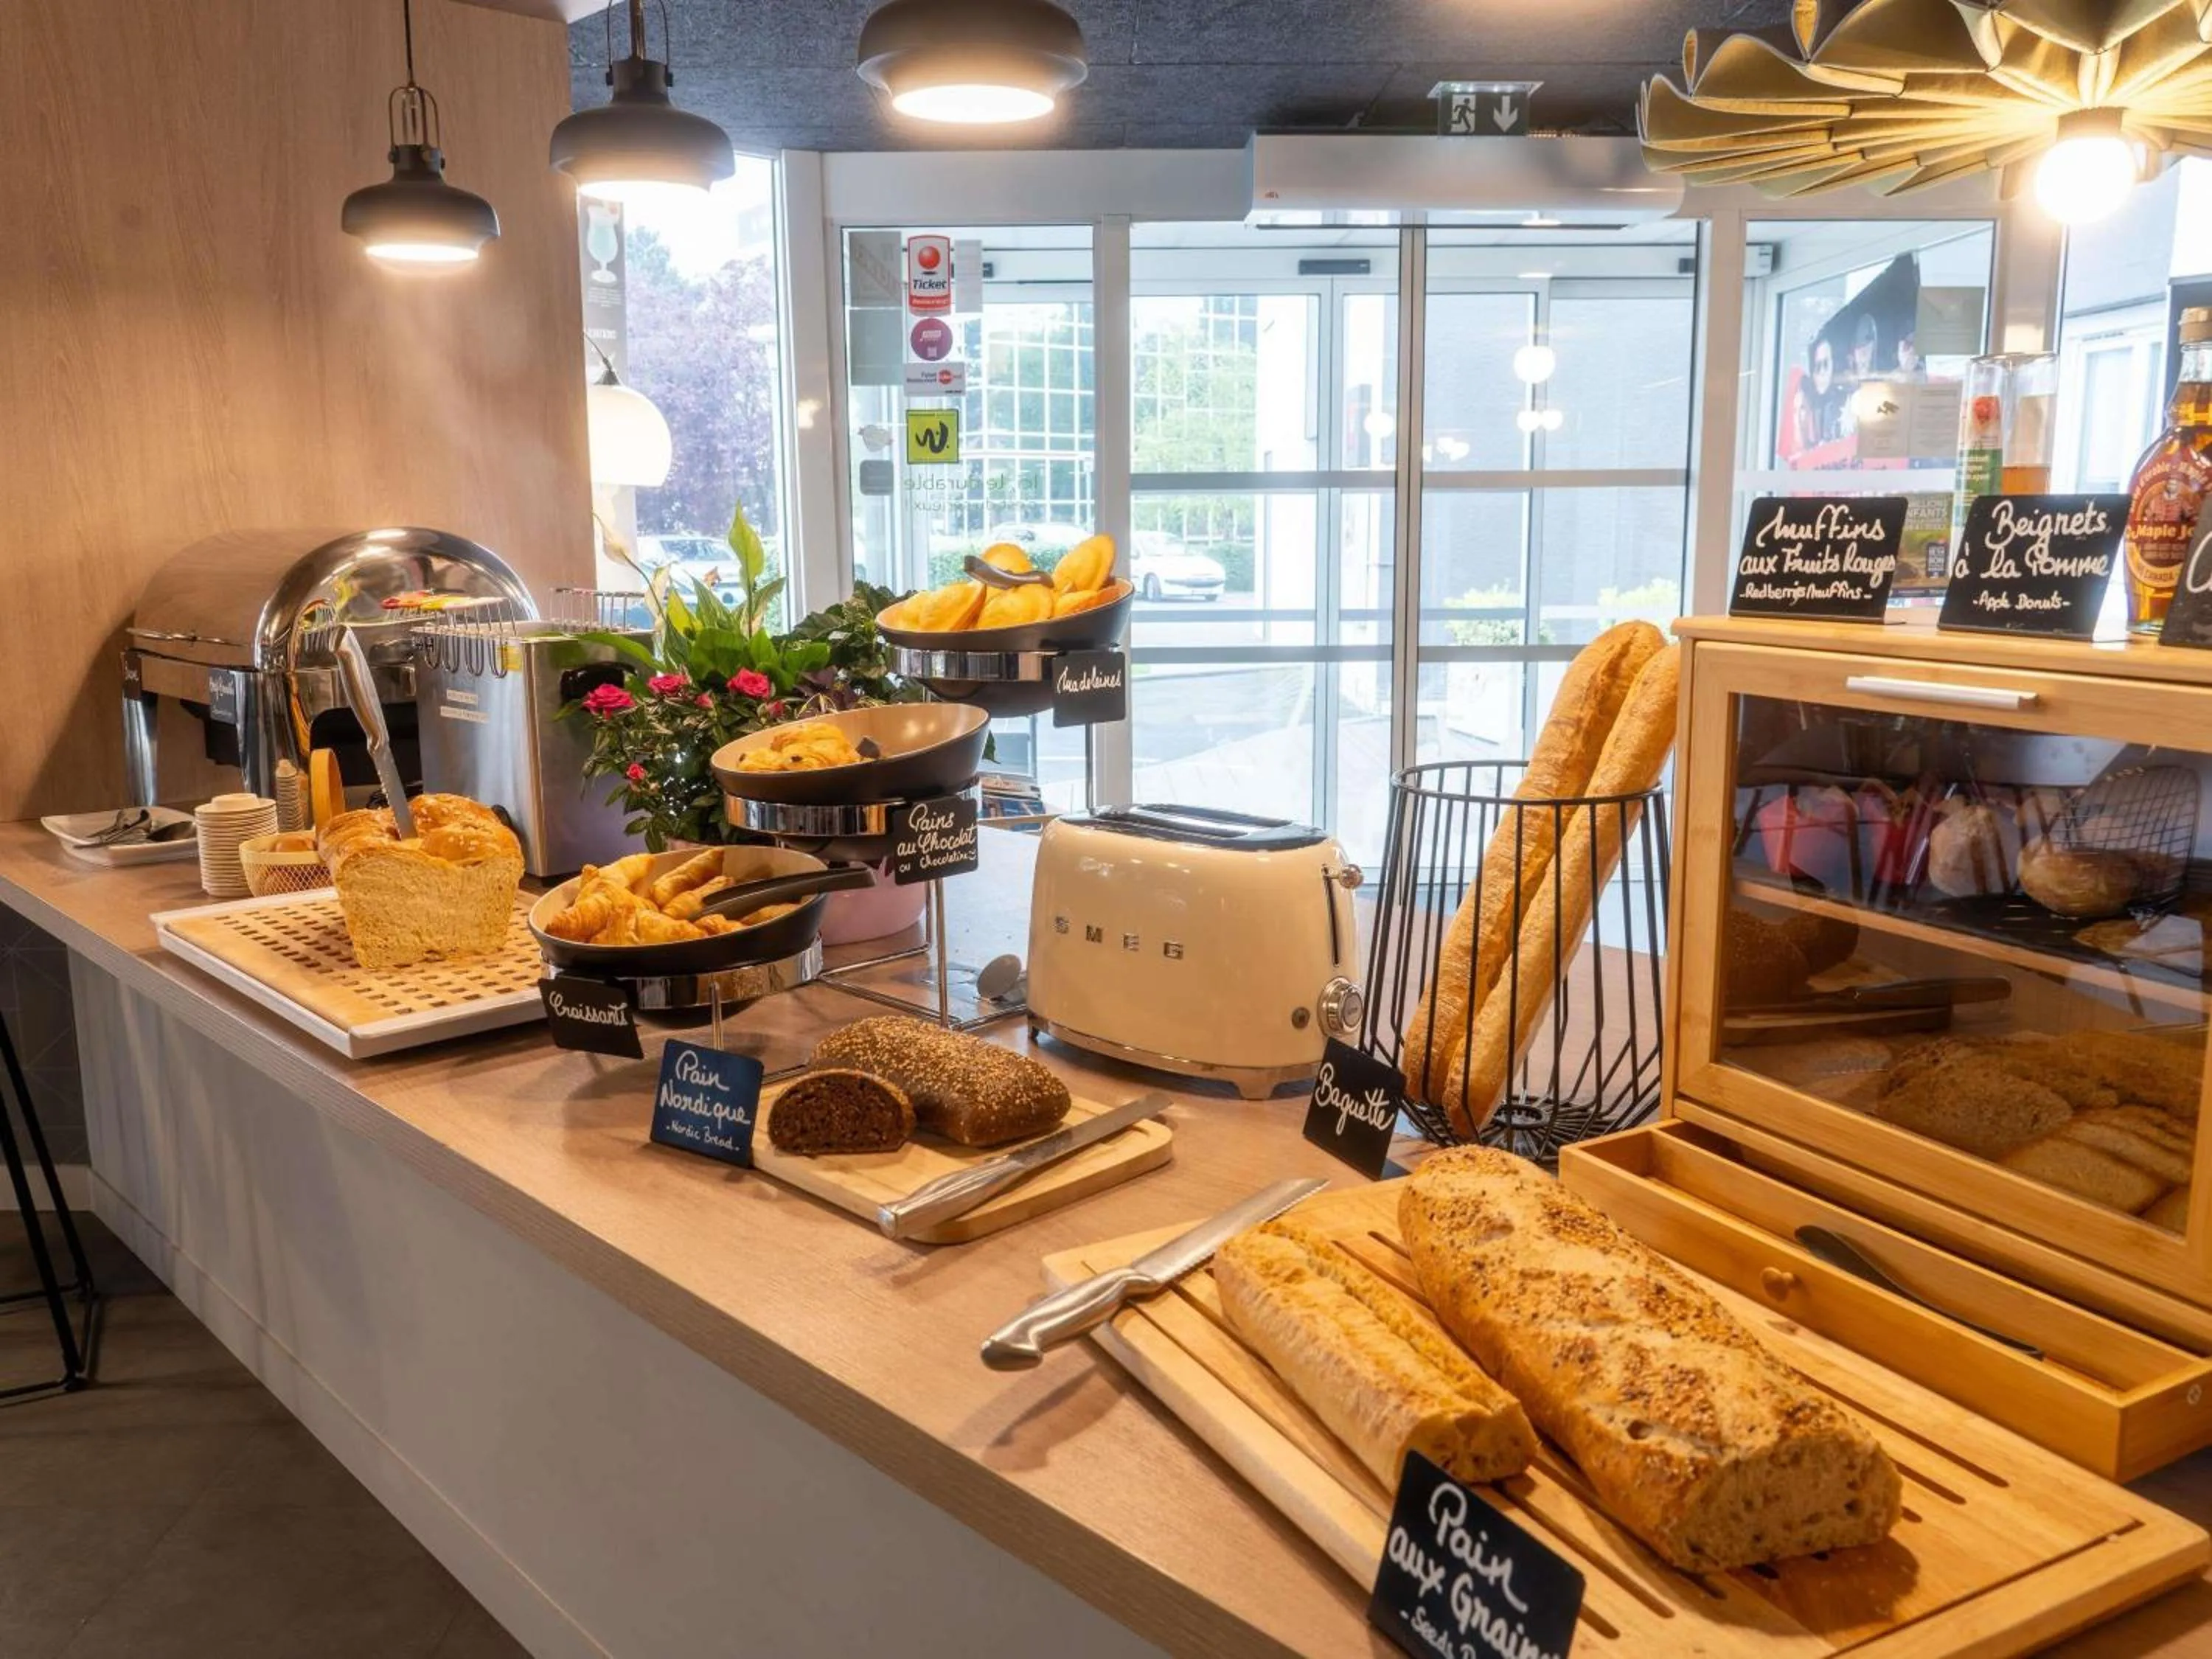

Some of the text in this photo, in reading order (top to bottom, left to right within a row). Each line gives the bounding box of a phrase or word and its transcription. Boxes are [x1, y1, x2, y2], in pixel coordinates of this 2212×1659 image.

[913, 279, 947, 290] Ticket
[1756, 504, 1885, 548] Muffins
[1985, 499, 2107, 565] Beignets
[2132, 524, 2176, 540] Maple
[1740, 541, 1896, 588] aux Fruits Rouges
[1955, 541, 1970, 579] à
[1980, 547, 2022, 578] la
[2025, 544, 2110, 577] Pomme
[1057, 665, 1121, 694] Madeleines
[908, 803, 955, 832] Pains
[897, 823, 977, 856] au Chocolat
[1054, 916, 1184, 961] SMEG
[549, 990, 629, 1026] Croissants
[675, 1049, 730, 1092] Pain
[660, 1078, 751, 1130] Nordique
[1315, 1062, 1394, 1136] Baguette
[1428, 1482, 1529, 1613] Pain
[1388, 1526, 1561, 1659] aux Grain
